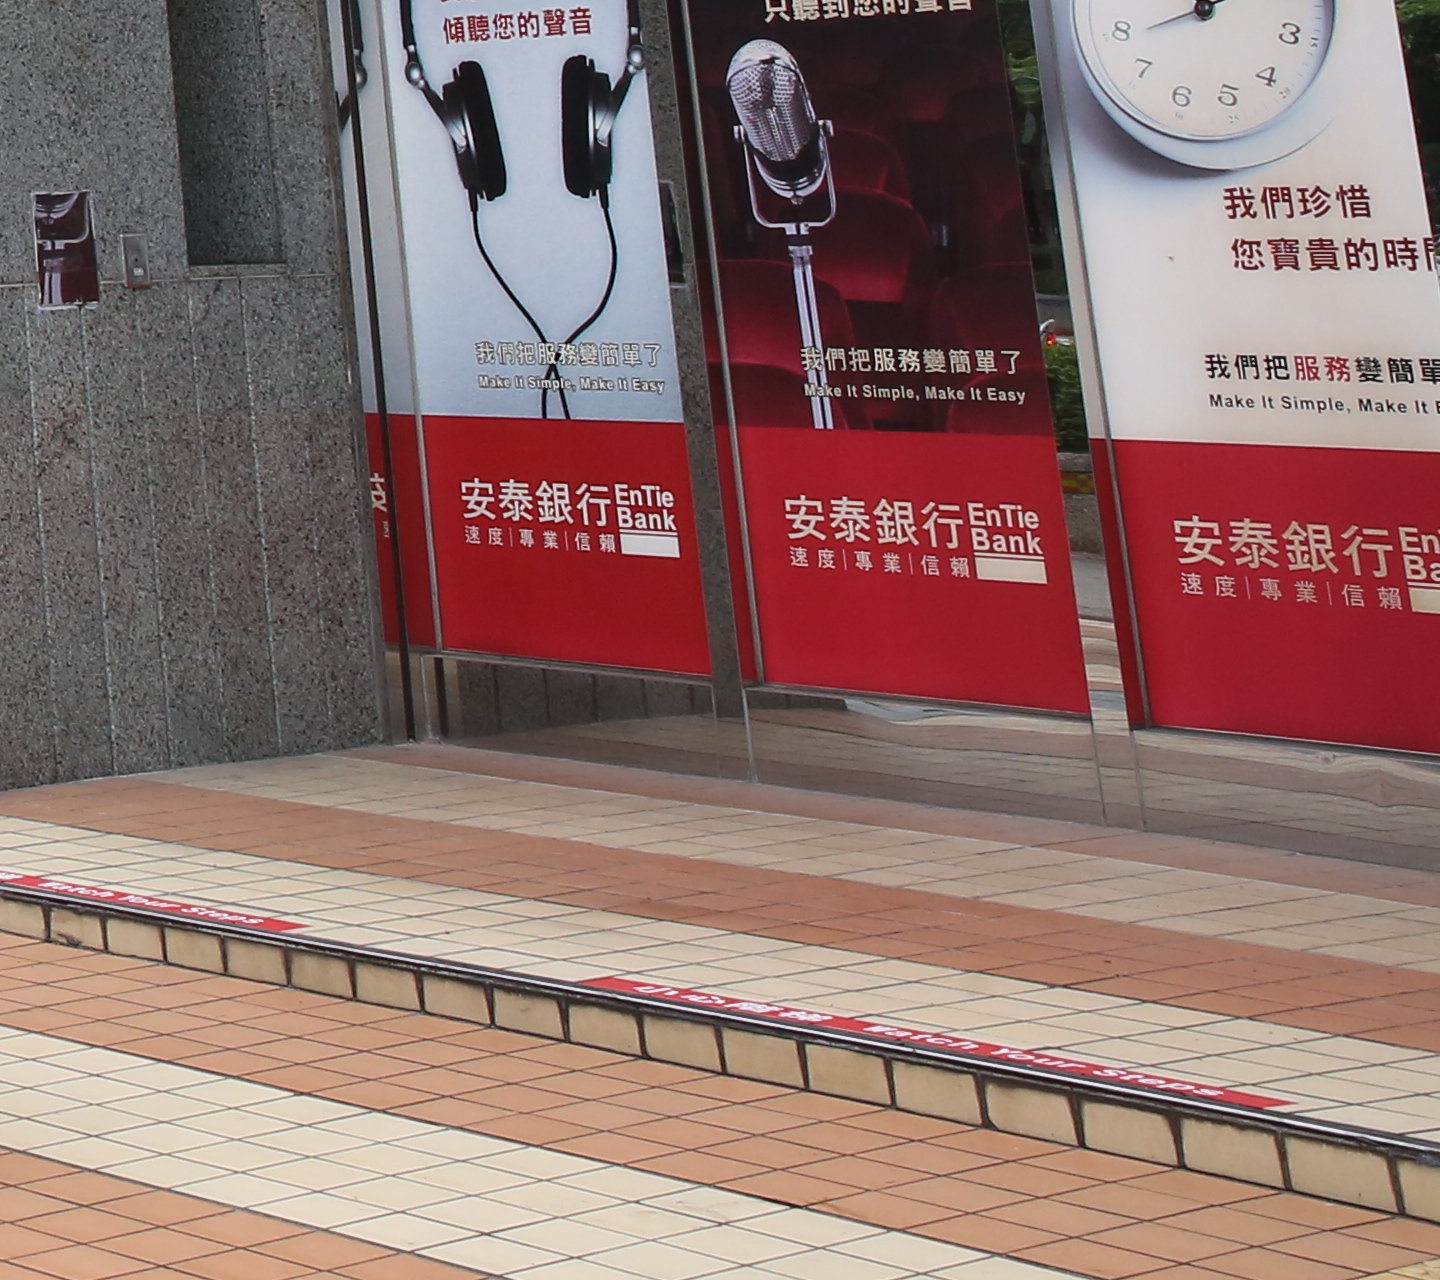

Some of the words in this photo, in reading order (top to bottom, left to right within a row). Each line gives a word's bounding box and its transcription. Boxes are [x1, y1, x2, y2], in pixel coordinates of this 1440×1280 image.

[443, 6, 593, 45] 傾聽您的聲音
[1112, 20, 1131, 42] 8
[1278, 22, 1301, 45] 3
[1135, 58, 1153, 78] 7
[1255, 66, 1277, 87] 4
[1172, 86, 1192, 107] 6
[1217, 83, 1240, 107] 5
[1222, 184, 1372, 220] 我們珍惜
[475, 342, 662, 369] 我們把服務變簡單了
[800, 346, 1022, 376] 我們把服務變簡單了
[478, 374, 511, 391] Make
[514, 376, 526, 391] It
[528, 375, 577, 394] Simple,
[579, 376, 614, 392] Make
[617, 378, 628, 392] It
[631, 378, 665, 396] Easy
[804, 382, 843, 399] Make
[846, 384, 858, 399] It
[861, 385, 920, 403] Simple,
[925, 386, 967, 402] Make
[970, 387, 982, 402] It
[986, 388, 1026, 405] Easy
[1209, 393, 1255, 409] Make
[1262, 394, 1276, 410] It
[1280, 395, 1351, 414] Simple,
[1358, 398, 1407, 414] Make
[1414, 399, 1430, 414] It
[460, 478, 614, 528] 安泰銀行
[615, 483, 674, 509] EnTie
[618, 506, 677, 532] Bank
[784, 495, 964, 550] 安泰銀行
[968, 502, 1040, 530] EnTie
[464, 525, 504, 548] 速度
[519, 527, 559, 551] 專業
[574, 530, 616, 554] 信賴
[972, 528, 1044, 555] Bank
[1173, 515, 1394, 578] 安泰銀行
[788, 546, 836, 571] 速度
[853, 549, 902, 575] 專業
[919, 552, 971, 579] 信賴
[1403, 554, 1440, 583] Ba
[1181, 573, 1237, 598] 速度
[1260, 577, 1319, 603] 專業
[1342, 583, 1403, 611] 信賴
[38, 880, 116, 899] Watch
[118, 894, 183, 913] Your
[181, 906, 265, 926] Steps
[862, 1024, 980, 1051] Watch
[990, 1047, 1088, 1073] Your
[1090, 1067, 1227, 1099] Steps
